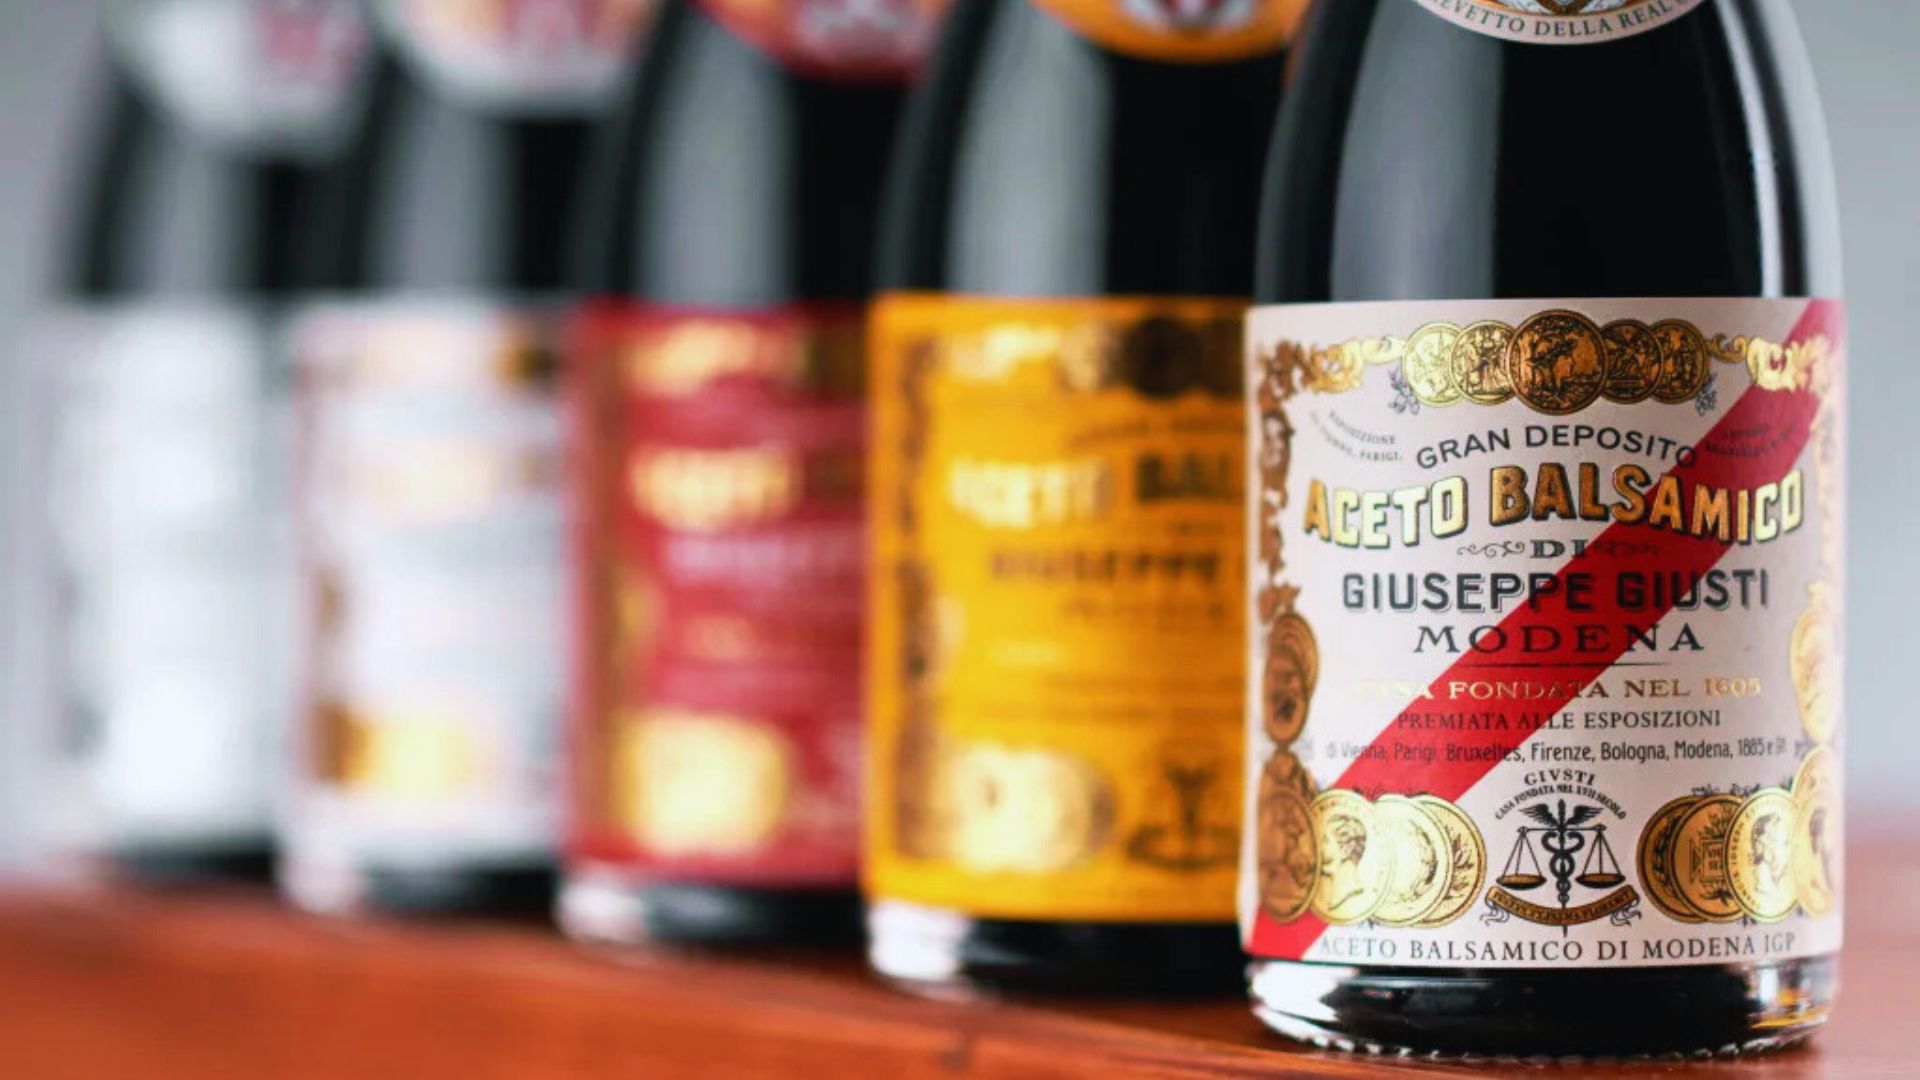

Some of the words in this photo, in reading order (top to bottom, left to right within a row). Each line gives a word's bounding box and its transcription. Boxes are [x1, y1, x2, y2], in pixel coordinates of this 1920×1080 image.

[1534, 18, 1613, 36] DELLA
[1416, 427, 1511, 469] GRAN
[1524, 424, 1697, 468] DEPOSITO
[1303, 474, 1470, 550] ACETO
[1489, 461, 1804, 546] BALSAMICO
[1529, 538, 1587, 559] DI
[1343, 572, 1594, 614] GIUSEPPE
[1616, 568, 1770, 611] GIUSTI
[1415, 622, 1705, 653] MODENA
[1448, 679, 1610, 699] FONDATA
[1624, 679, 1691, 698] NEL
[1705, 676, 1763, 697] 1605
[1398, 712, 1508, 731] PREMIATA
[1516, 711, 1575, 730] ALLE
[1584, 709, 1722, 729] ESPOSIZIONI
[1446, 742, 1526, 764] Bruxelles,
[1531, 741, 1596, 763] Firenze,
[1600, 741, 1670, 764] Bologna,
[1674, 739, 1733, 760] Modena,
[1523, 768, 1597, 786] GIVSTI
[1320, 936, 1397, 958] ACETO
[1410, 940, 1583, 961] BALSAMICO
[1597, 940, 1628, 960] DI
[1642, 936, 1755, 959] MODENA
[1764, 932, 1796, 951] IGP
